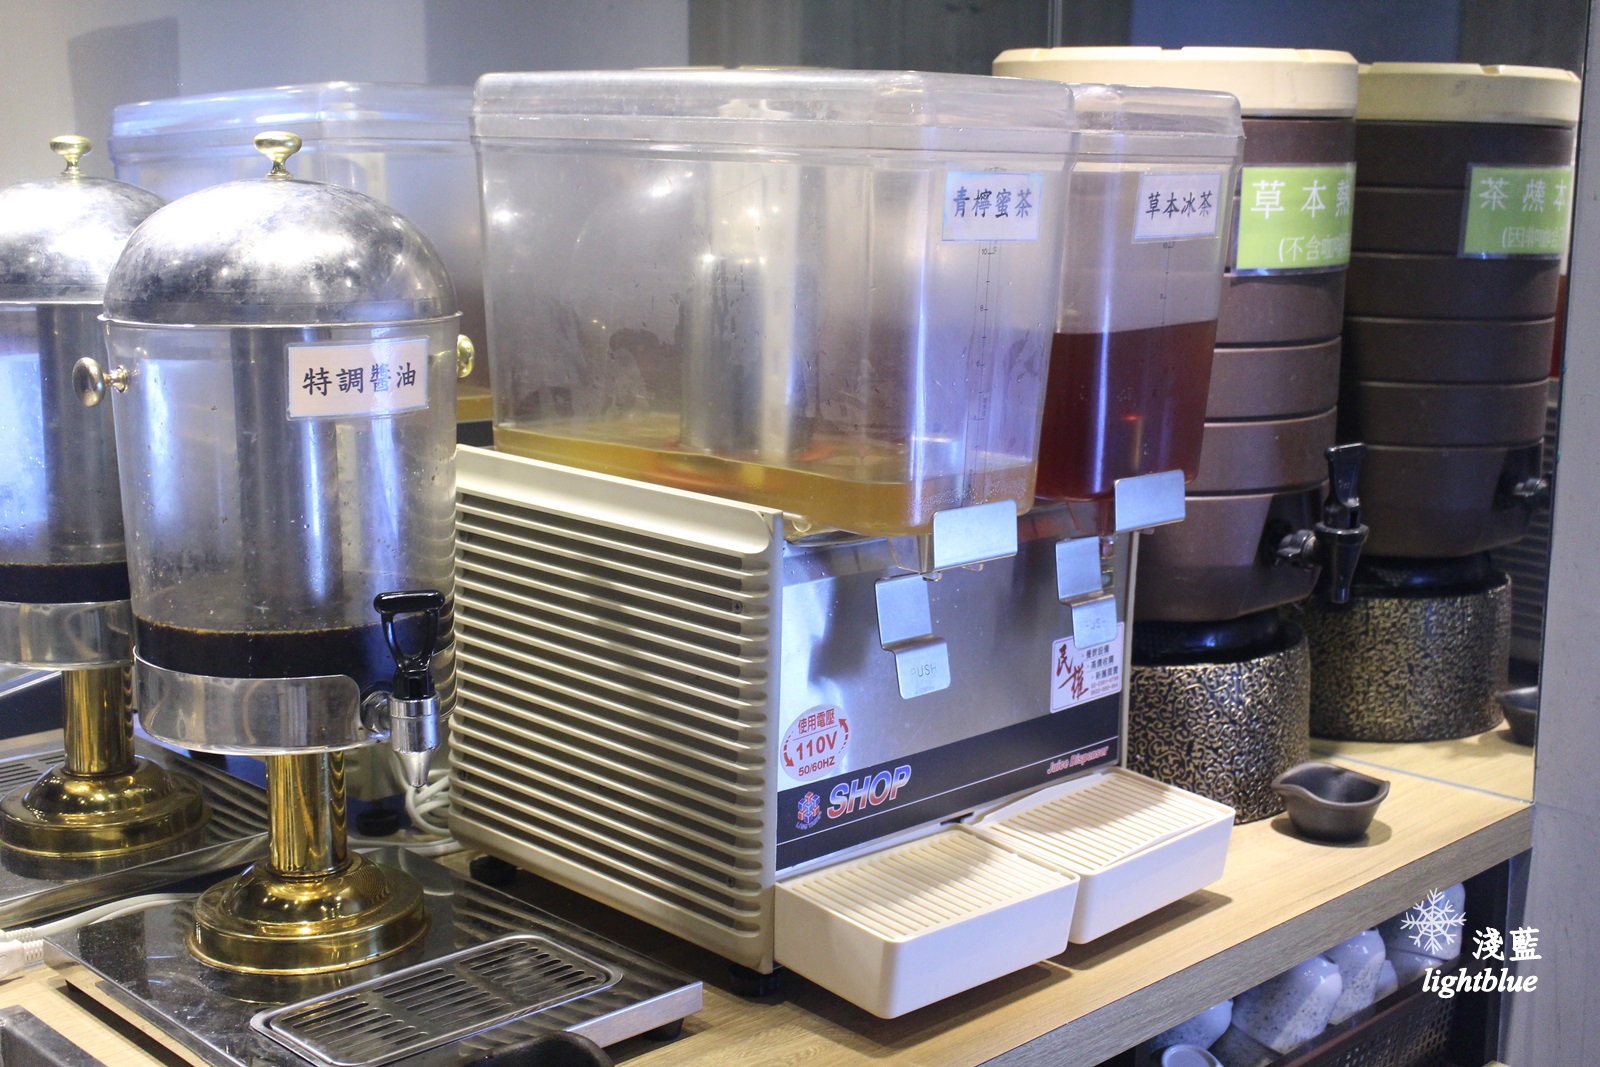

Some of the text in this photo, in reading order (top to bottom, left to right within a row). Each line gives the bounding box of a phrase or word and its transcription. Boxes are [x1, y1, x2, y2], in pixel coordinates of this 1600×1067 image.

[953, 186, 1032, 218] 青檸蜜茶
[1146, 191, 1212, 220] 草本冰茶
[302, 362, 416, 397] 特調醬油
[798, 708, 835, 735] 使用電壓
[796, 731, 838, 761] 110V
[1046, 745, 1109, 775] Juice Dispenser
[798, 755, 836, 777] 50/60HZ
[826, 764, 912, 819] SHOP
